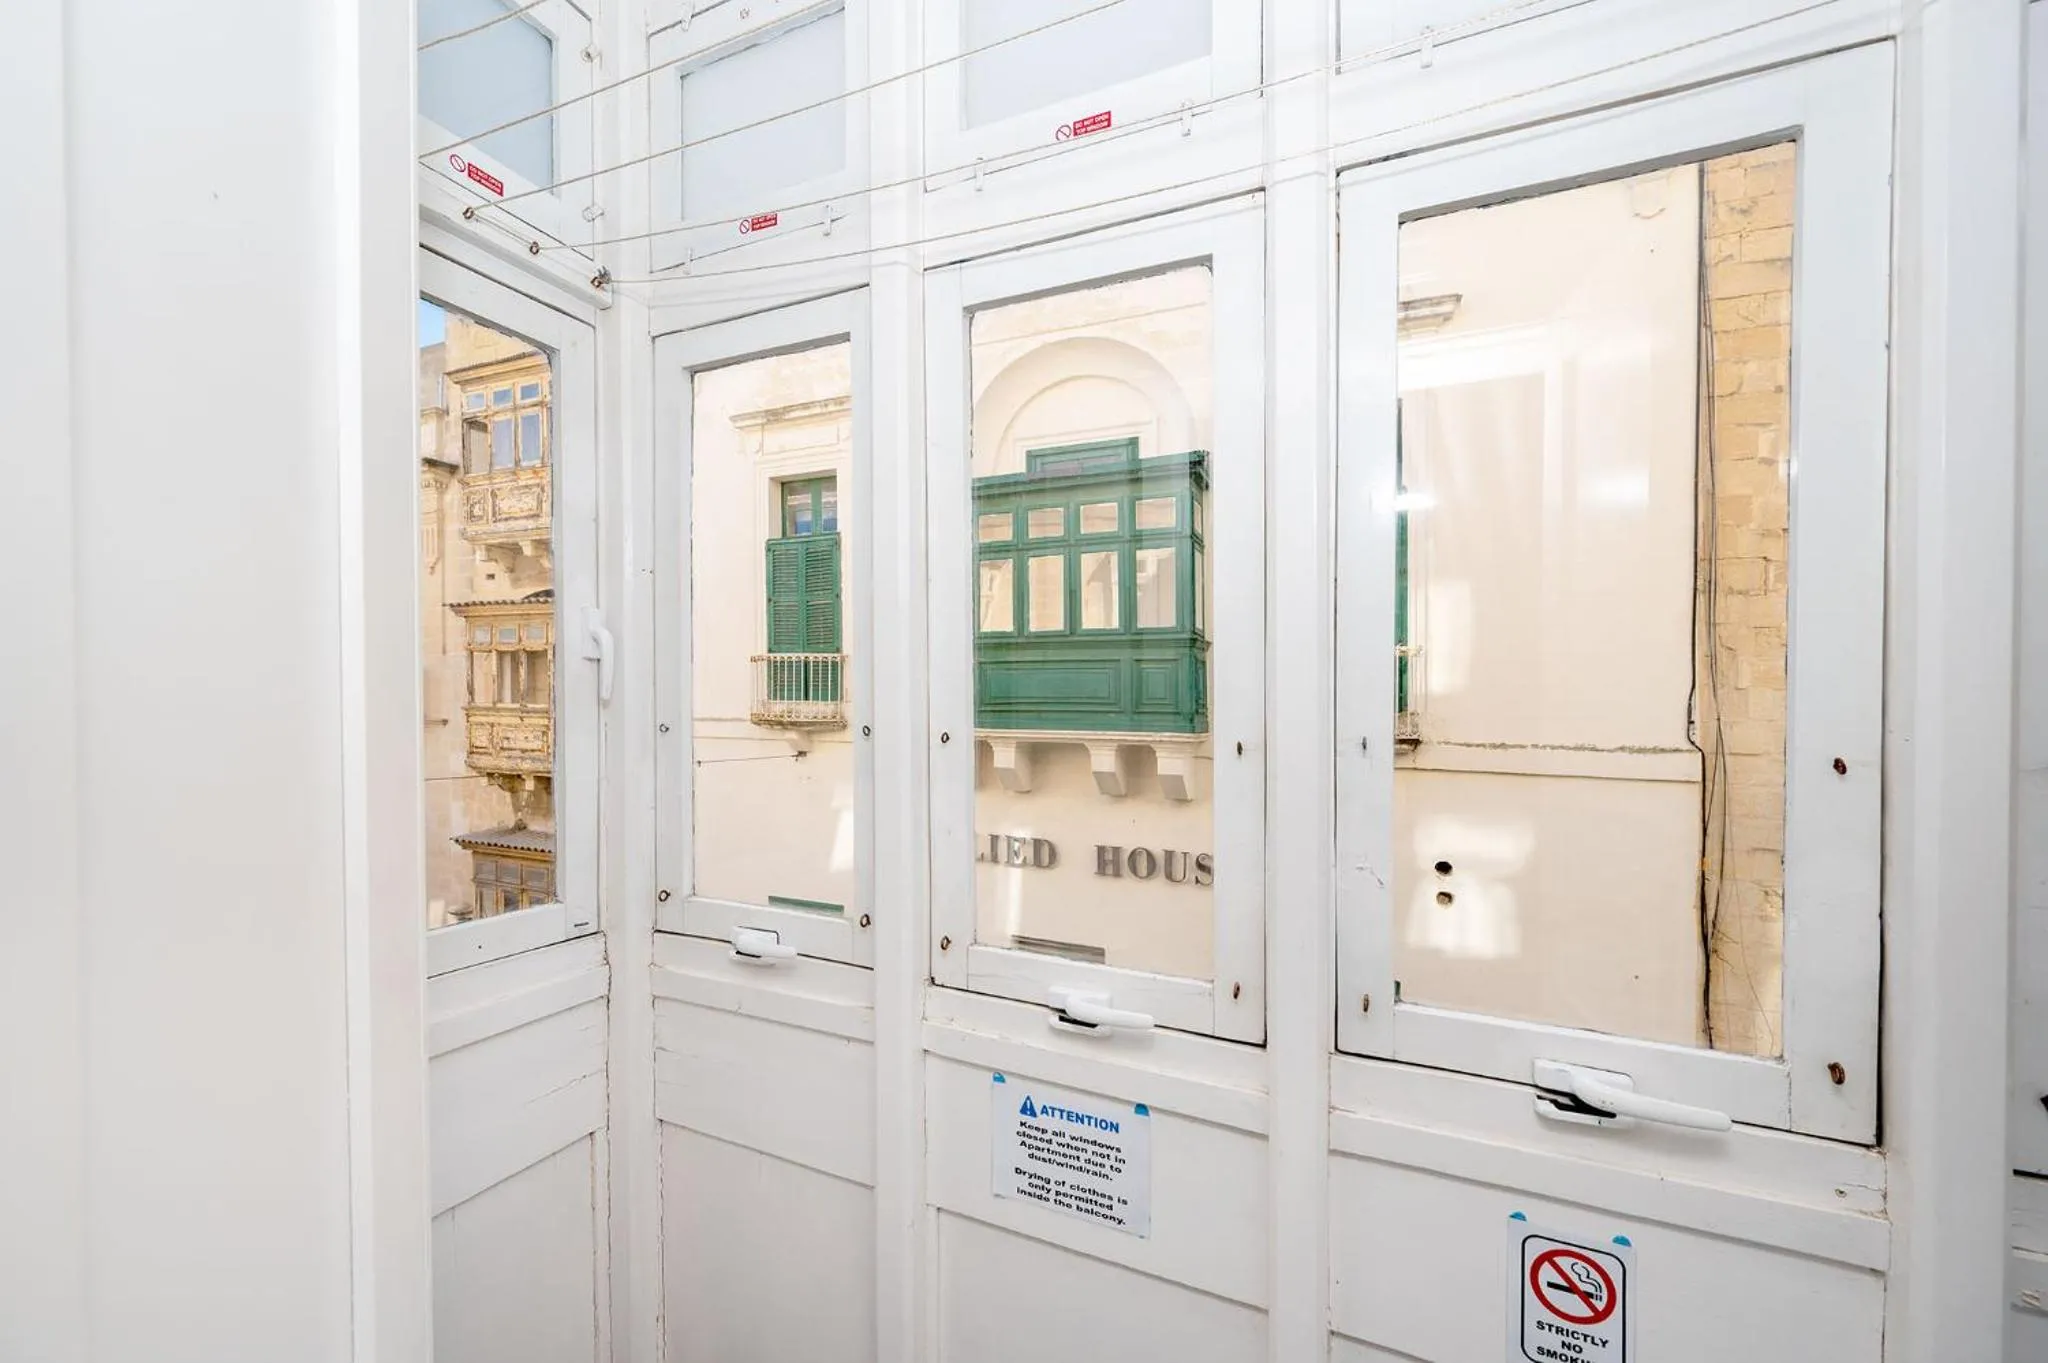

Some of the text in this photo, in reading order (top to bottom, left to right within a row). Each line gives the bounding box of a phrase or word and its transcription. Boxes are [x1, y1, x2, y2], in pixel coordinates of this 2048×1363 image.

[1040, 1104, 1120, 1133] ATTENTION
[1016, 1130, 1126, 1165] closed when not in
[1019, 1120, 1122, 1153] Keep all windows
[1019, 1140, 1122, 1174] Apartment due to
[1027, 1152, 1113, 1182] dust/wind/rain.
[1014, 1167, 1128, 1206] Drying of clothes is
[1028, 1180, 1113, 1211] only permitted
[1016, 1187, 1127, 1225] inside the balcony.
[1536, 1320, 1609, 1349] STRICTLY
[1561, 1340, 1583, 1354] NO
